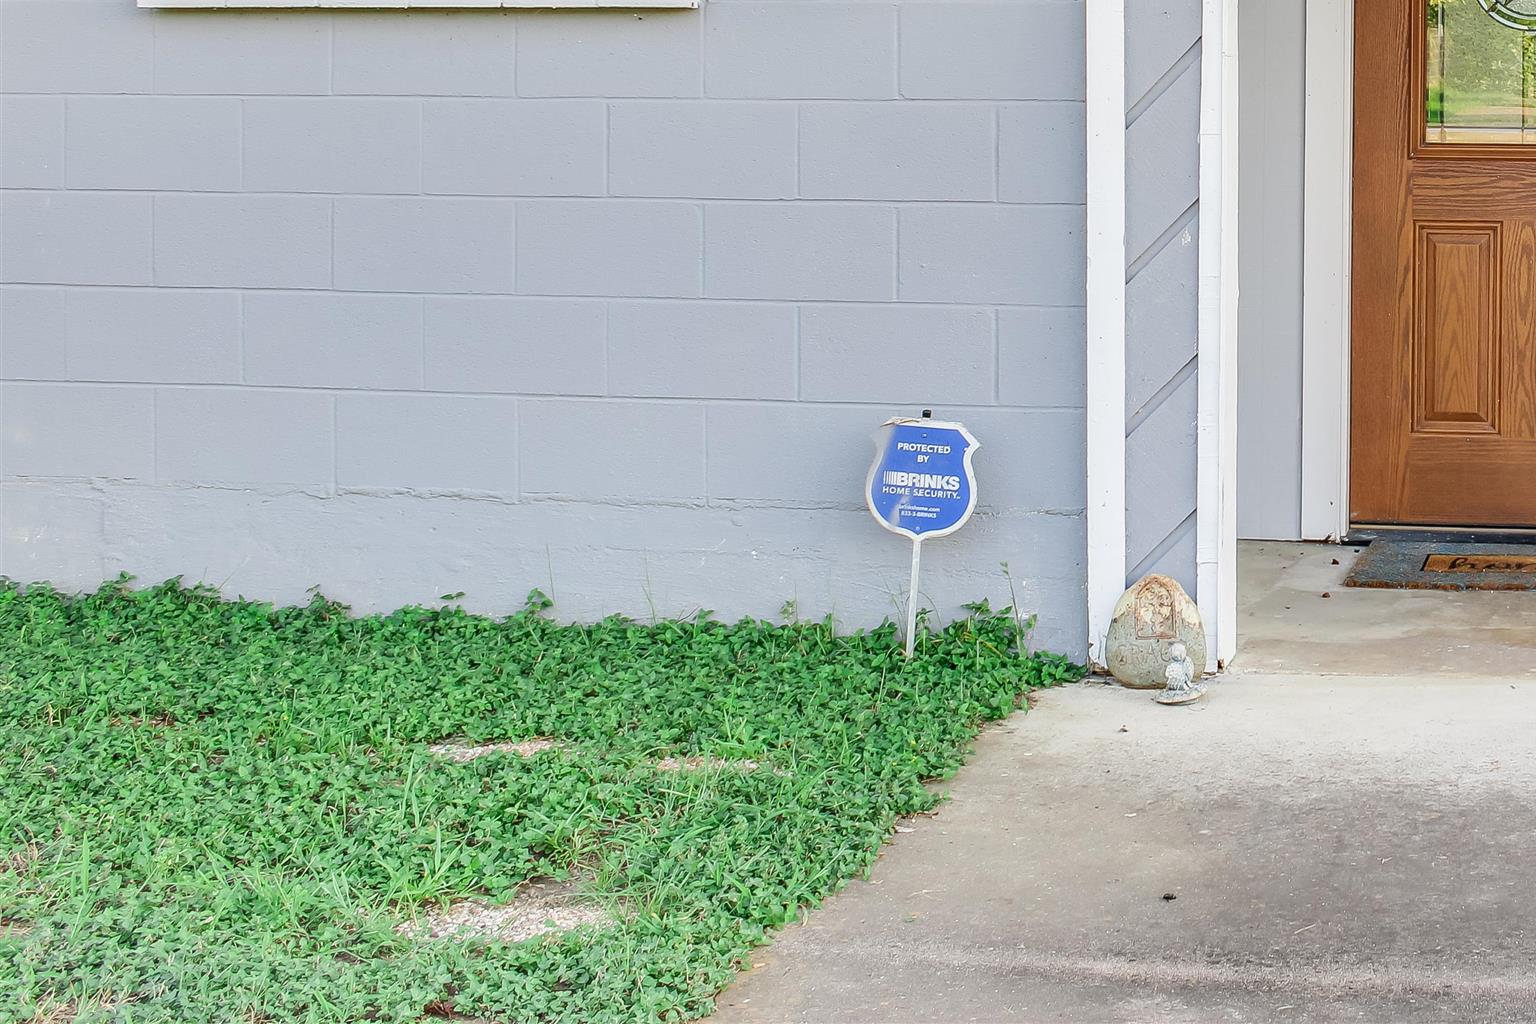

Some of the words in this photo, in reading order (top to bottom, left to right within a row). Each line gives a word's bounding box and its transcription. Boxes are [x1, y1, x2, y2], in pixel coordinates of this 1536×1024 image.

[897, 442, 951, 454] PROTECTED
[917, 455, 930, 463] BY
[896, 471, 960, 491] BRINKS
[882, 486, 911, 496] HOME
[913, 489, 958, 499] SECURITY
